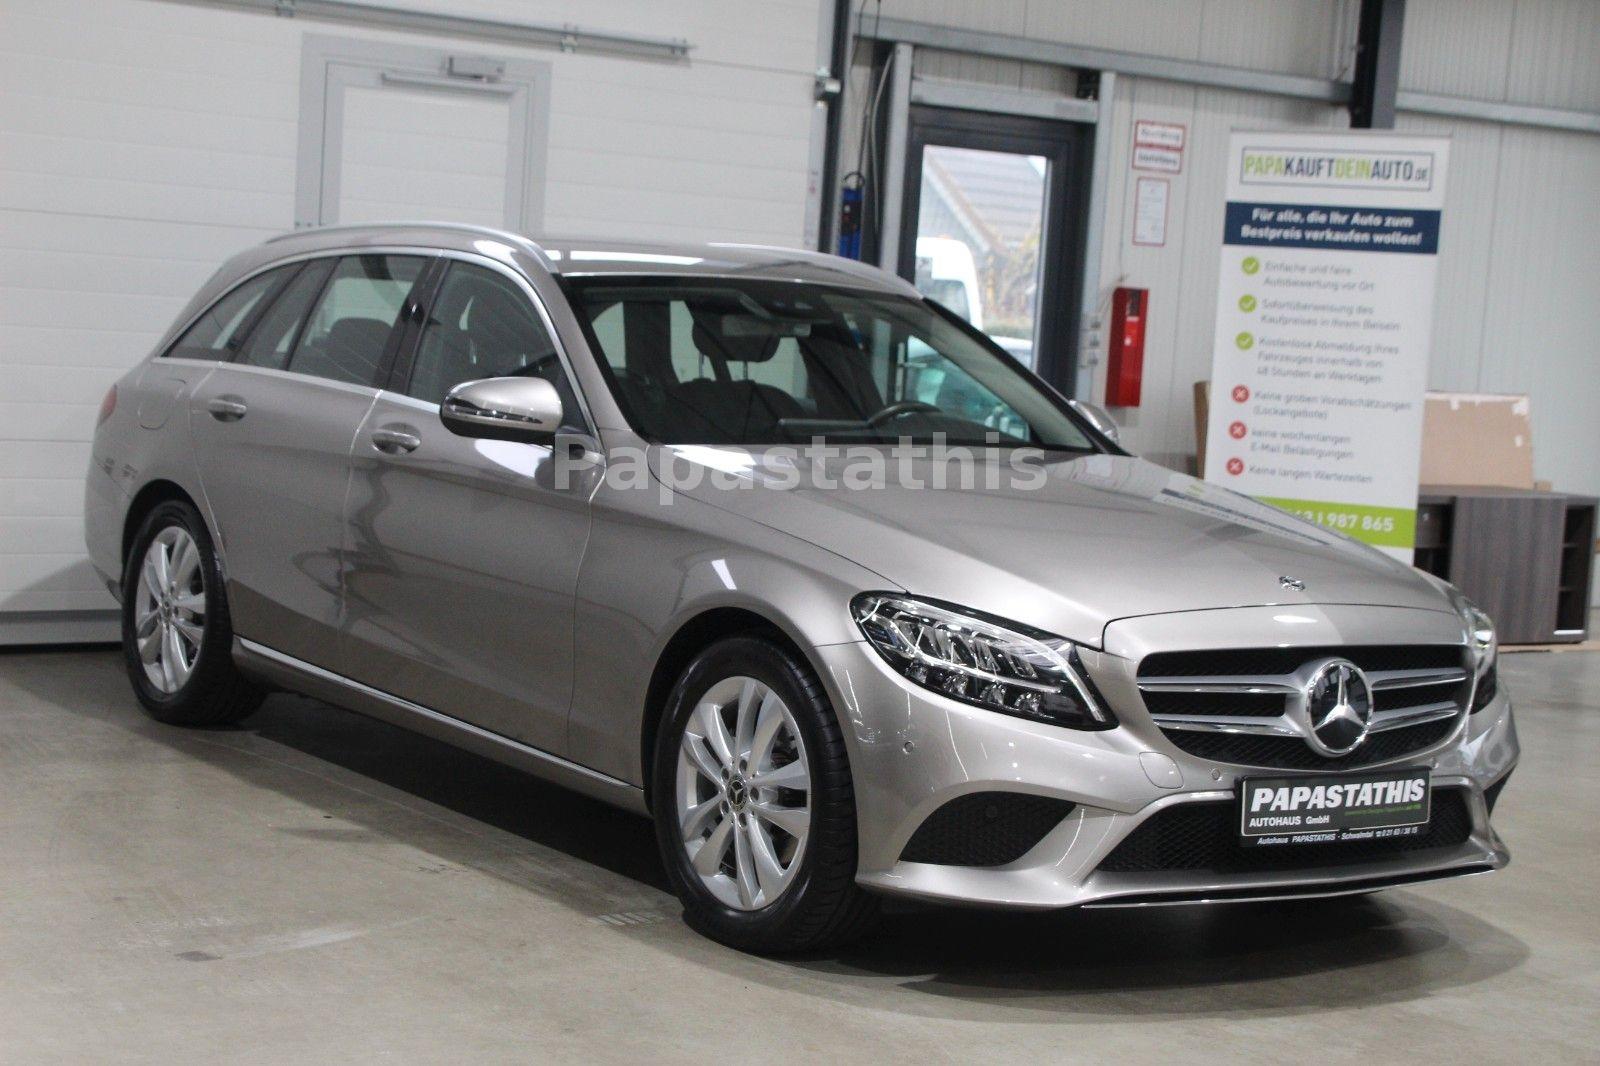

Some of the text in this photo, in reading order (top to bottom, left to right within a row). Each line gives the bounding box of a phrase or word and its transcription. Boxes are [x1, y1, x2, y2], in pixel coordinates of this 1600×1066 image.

[1252, 208, 1274, 222] Für
[1307, 209, 1327, 223] die
[1329, 211, 1348, 224] Ihr
[1350, 212, 1382, 227] Auto
[1384, 215, 1414, 228] zum
[1241, 224, 1423, 246] Bestpreis verkaufen wollen!
[1264, 261, 1352, 276] Einfache und faire
[1263, 277, 1375, 292] Autobewertung vor Ort
[1356, 304, 1374, 315] des
[1260, 315, 1318, 328] Kaufpreises
[1320, 317, 1330, 327] in
[1258, 336, 1399, 354] Kostenlose Abmeldung Ihres
[1258, 352, 1383, 369] Fahrzeuges innerhalb von
[1272, 366, 1311, 379] Stunden
[1314, 371, 1327, 380] an
[1329, 371, 1382, 385] Werktagen
[1254, 390, 1282, 402] Keine
[1279, 429, 1351, 445] wochenlangen
[1250, 443, 1281, 454] E-Mail
[1249, 464, 1373, 484] Keine langen Wartezeiten
[1327, 513, 1358, 529] 987
[1361, 515, 1395, 532] 865
[1251, 779, 1426, 812] PAPASTATHIS
[1249, 814, 1330, 828] AUTOHAUS GmbH
[1257, 836, 1289, 845] Autohaus
[1291, 833, 1336, 843] PAPASTATHIS
